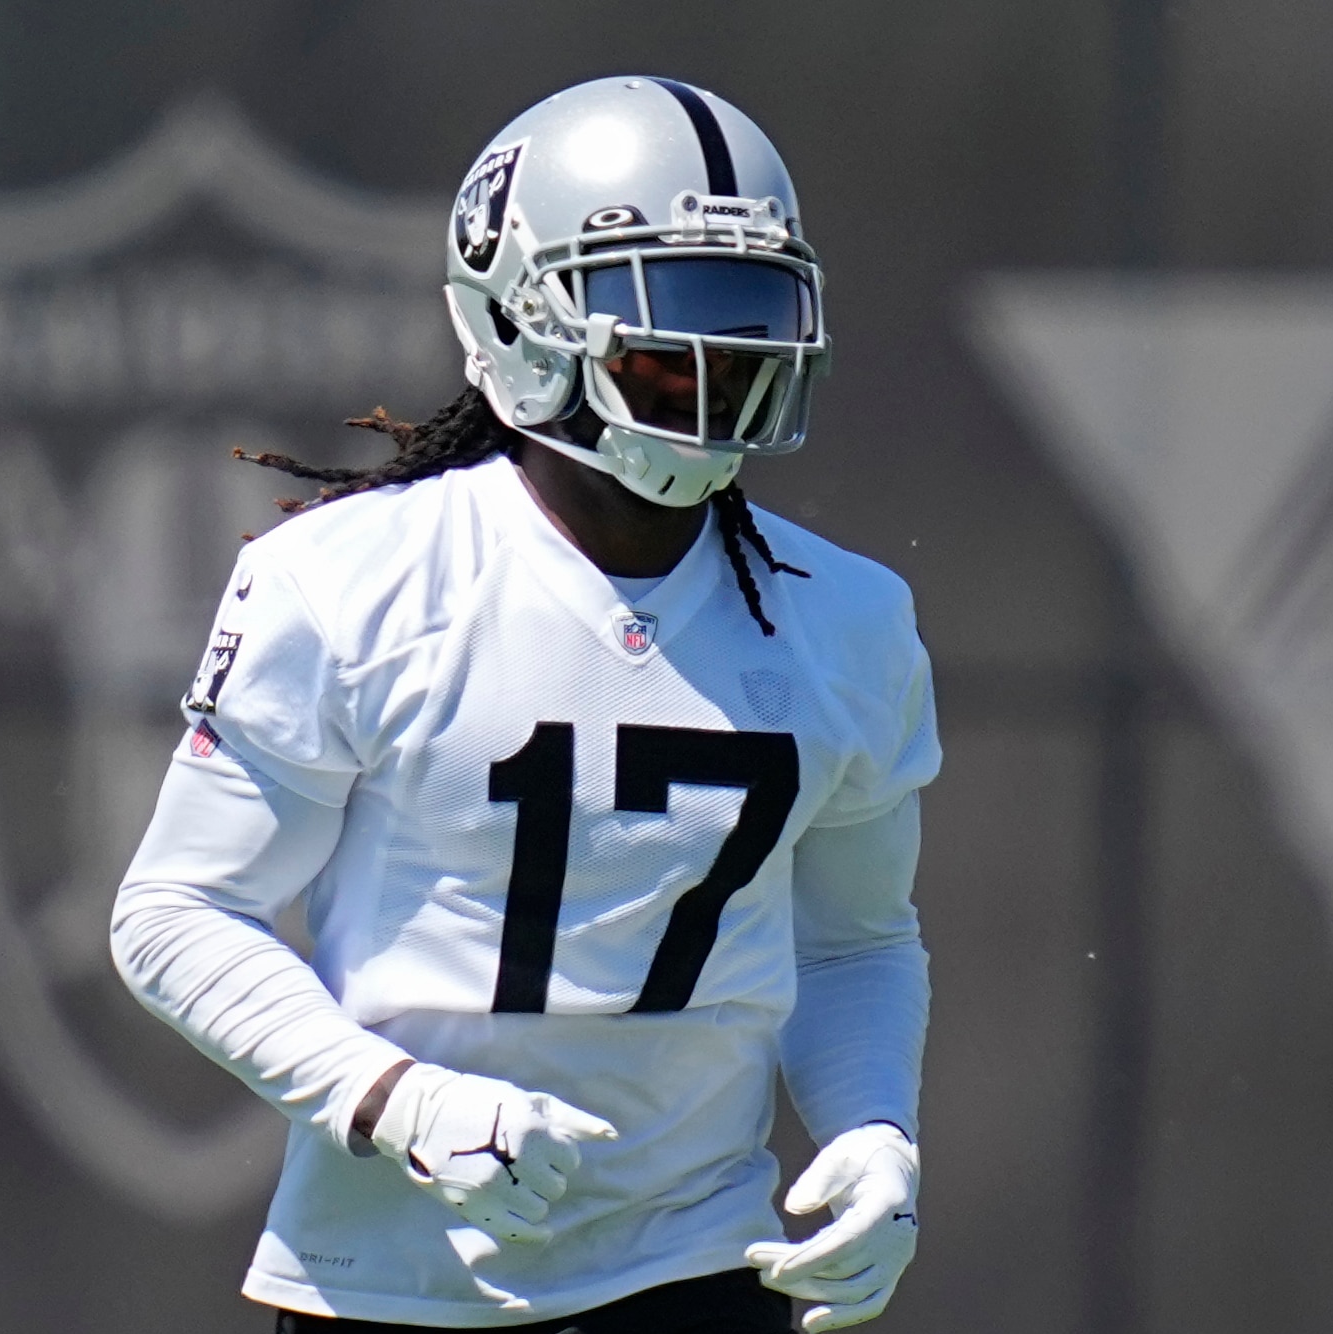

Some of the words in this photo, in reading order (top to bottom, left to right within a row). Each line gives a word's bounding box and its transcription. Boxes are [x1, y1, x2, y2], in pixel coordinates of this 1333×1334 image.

[703, 205, 750, 218] RAIDERS
[627, 634, 645, 648] NFL
[488, 721, 800, 1014] 17
[299, 1252, 355, 1269] DRI-FIT
